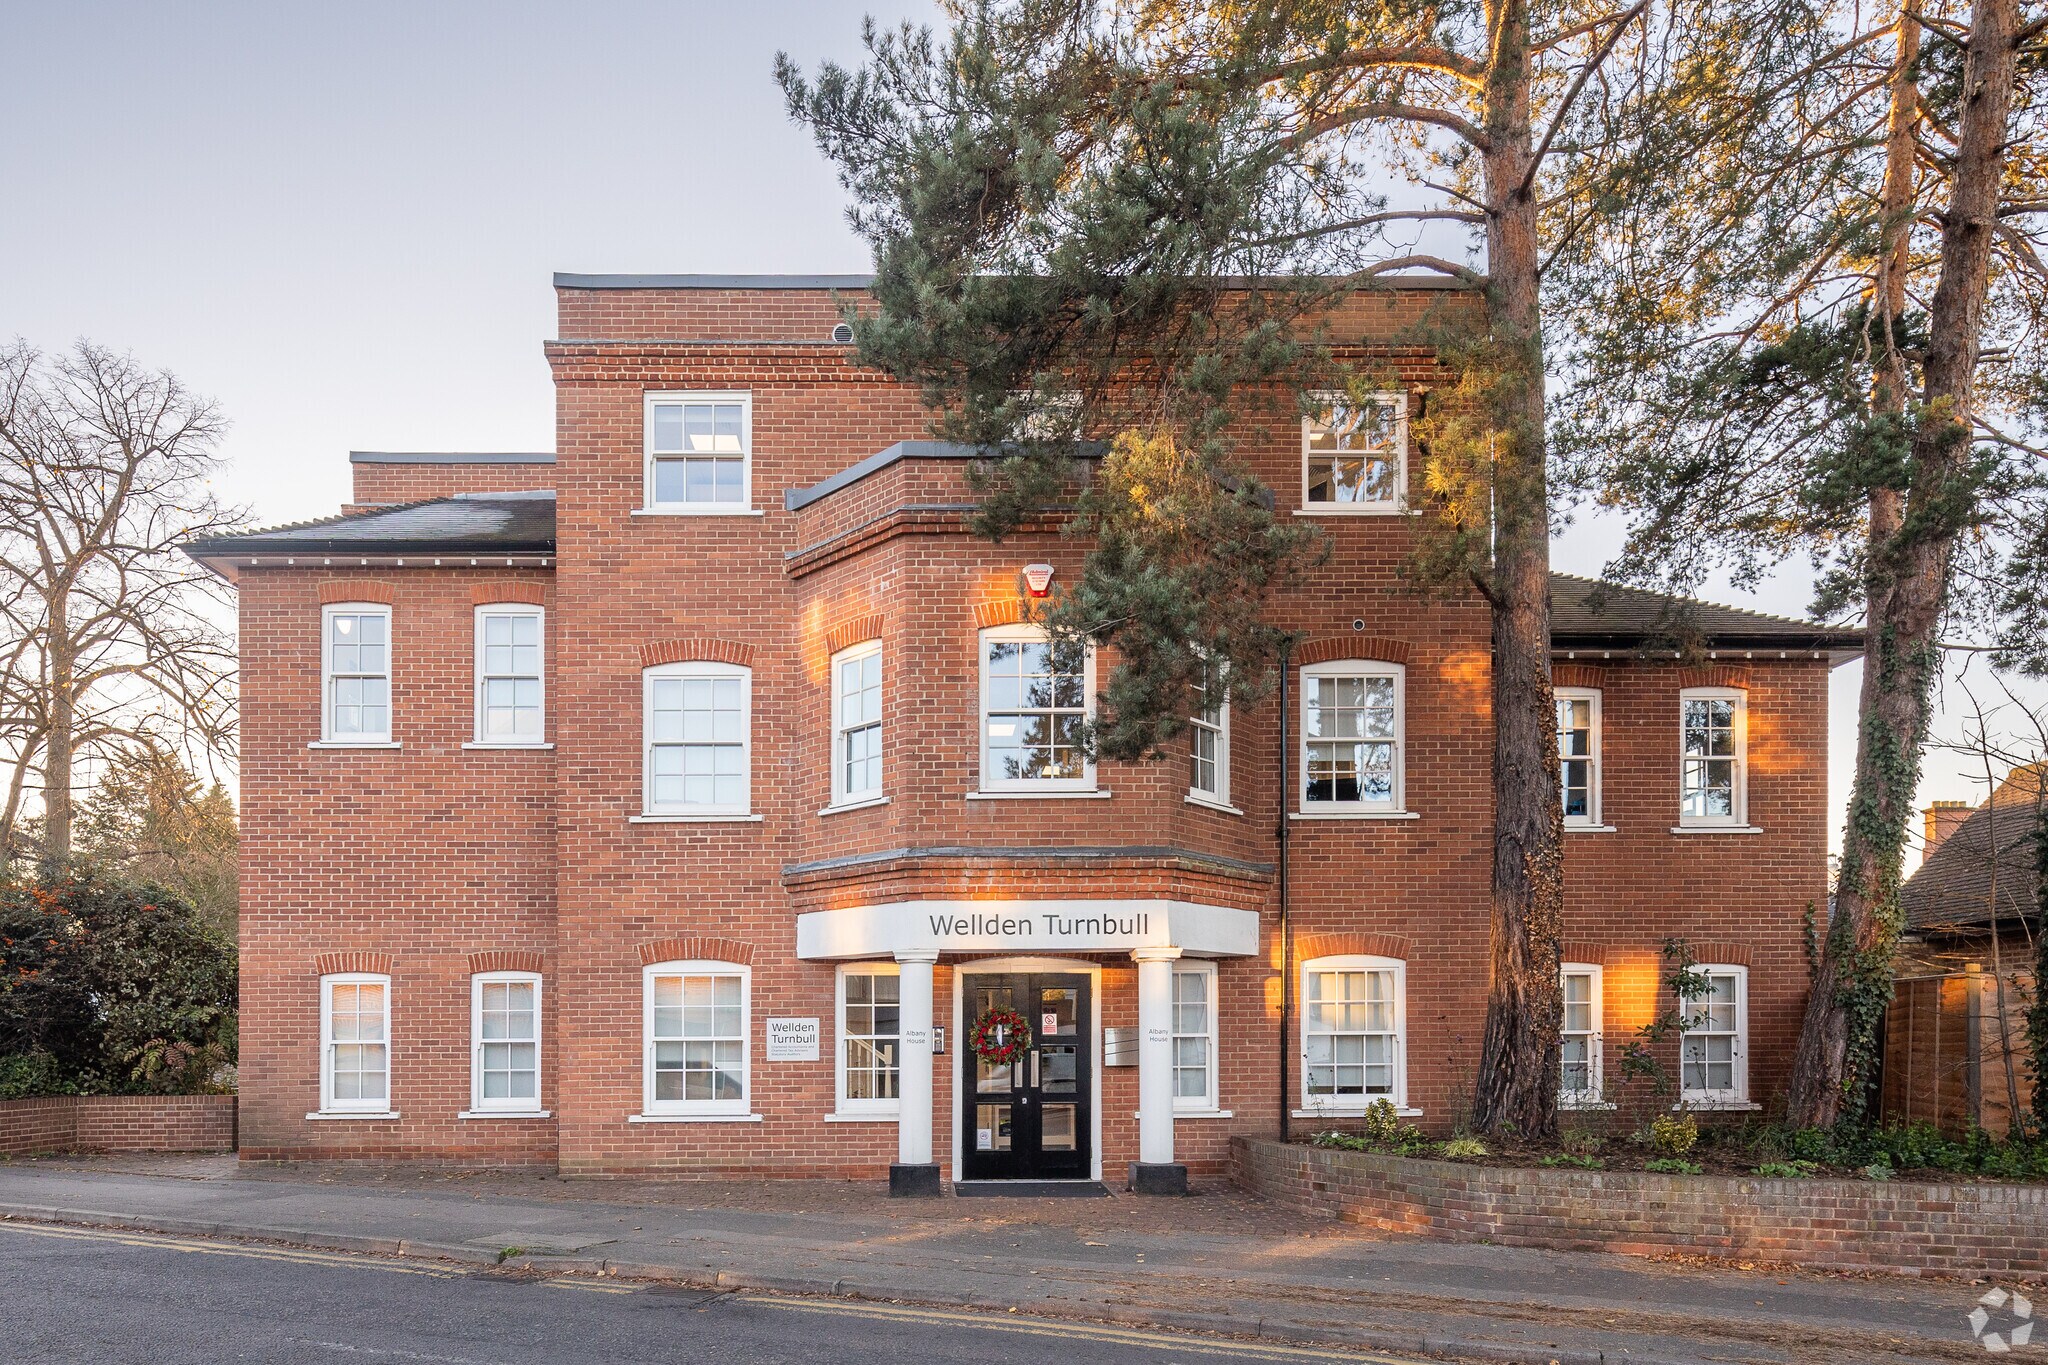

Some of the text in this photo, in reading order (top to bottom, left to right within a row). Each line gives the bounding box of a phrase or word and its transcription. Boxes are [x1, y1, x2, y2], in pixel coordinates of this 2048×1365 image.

[929, 913, 1149, 936] Wellden Turnbull
[771, 1022, 815, 1032] Wellden
[771, 1034, 816, 1044] Turnbull
